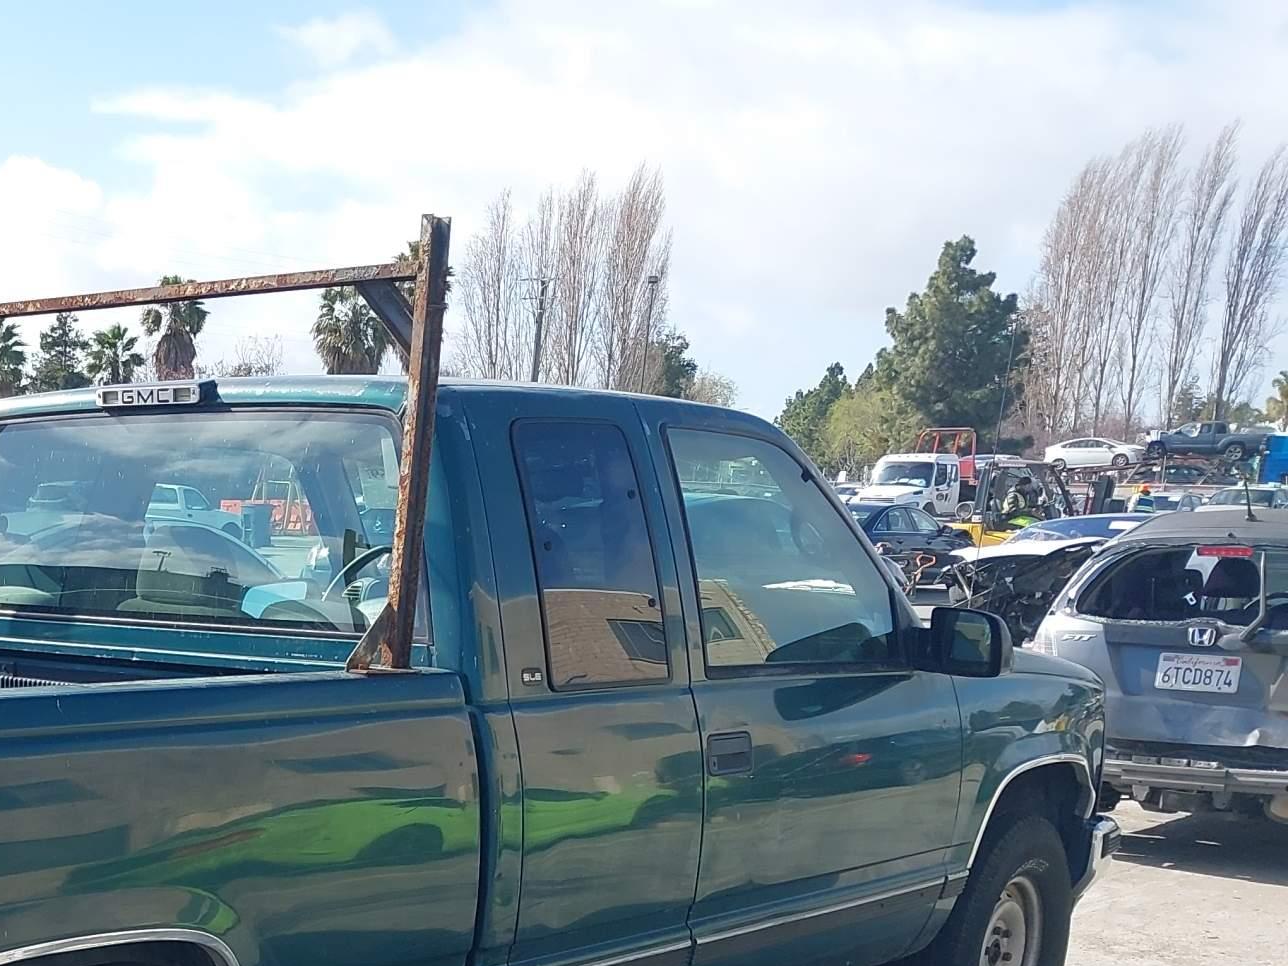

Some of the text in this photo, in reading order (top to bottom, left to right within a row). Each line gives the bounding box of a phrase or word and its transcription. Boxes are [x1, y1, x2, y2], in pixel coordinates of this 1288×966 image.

[122, 389, 169, 404] GMC
[1062, 634, 1097, 642] FIT
[1162, 666, 1232, 688] 6TCD874
